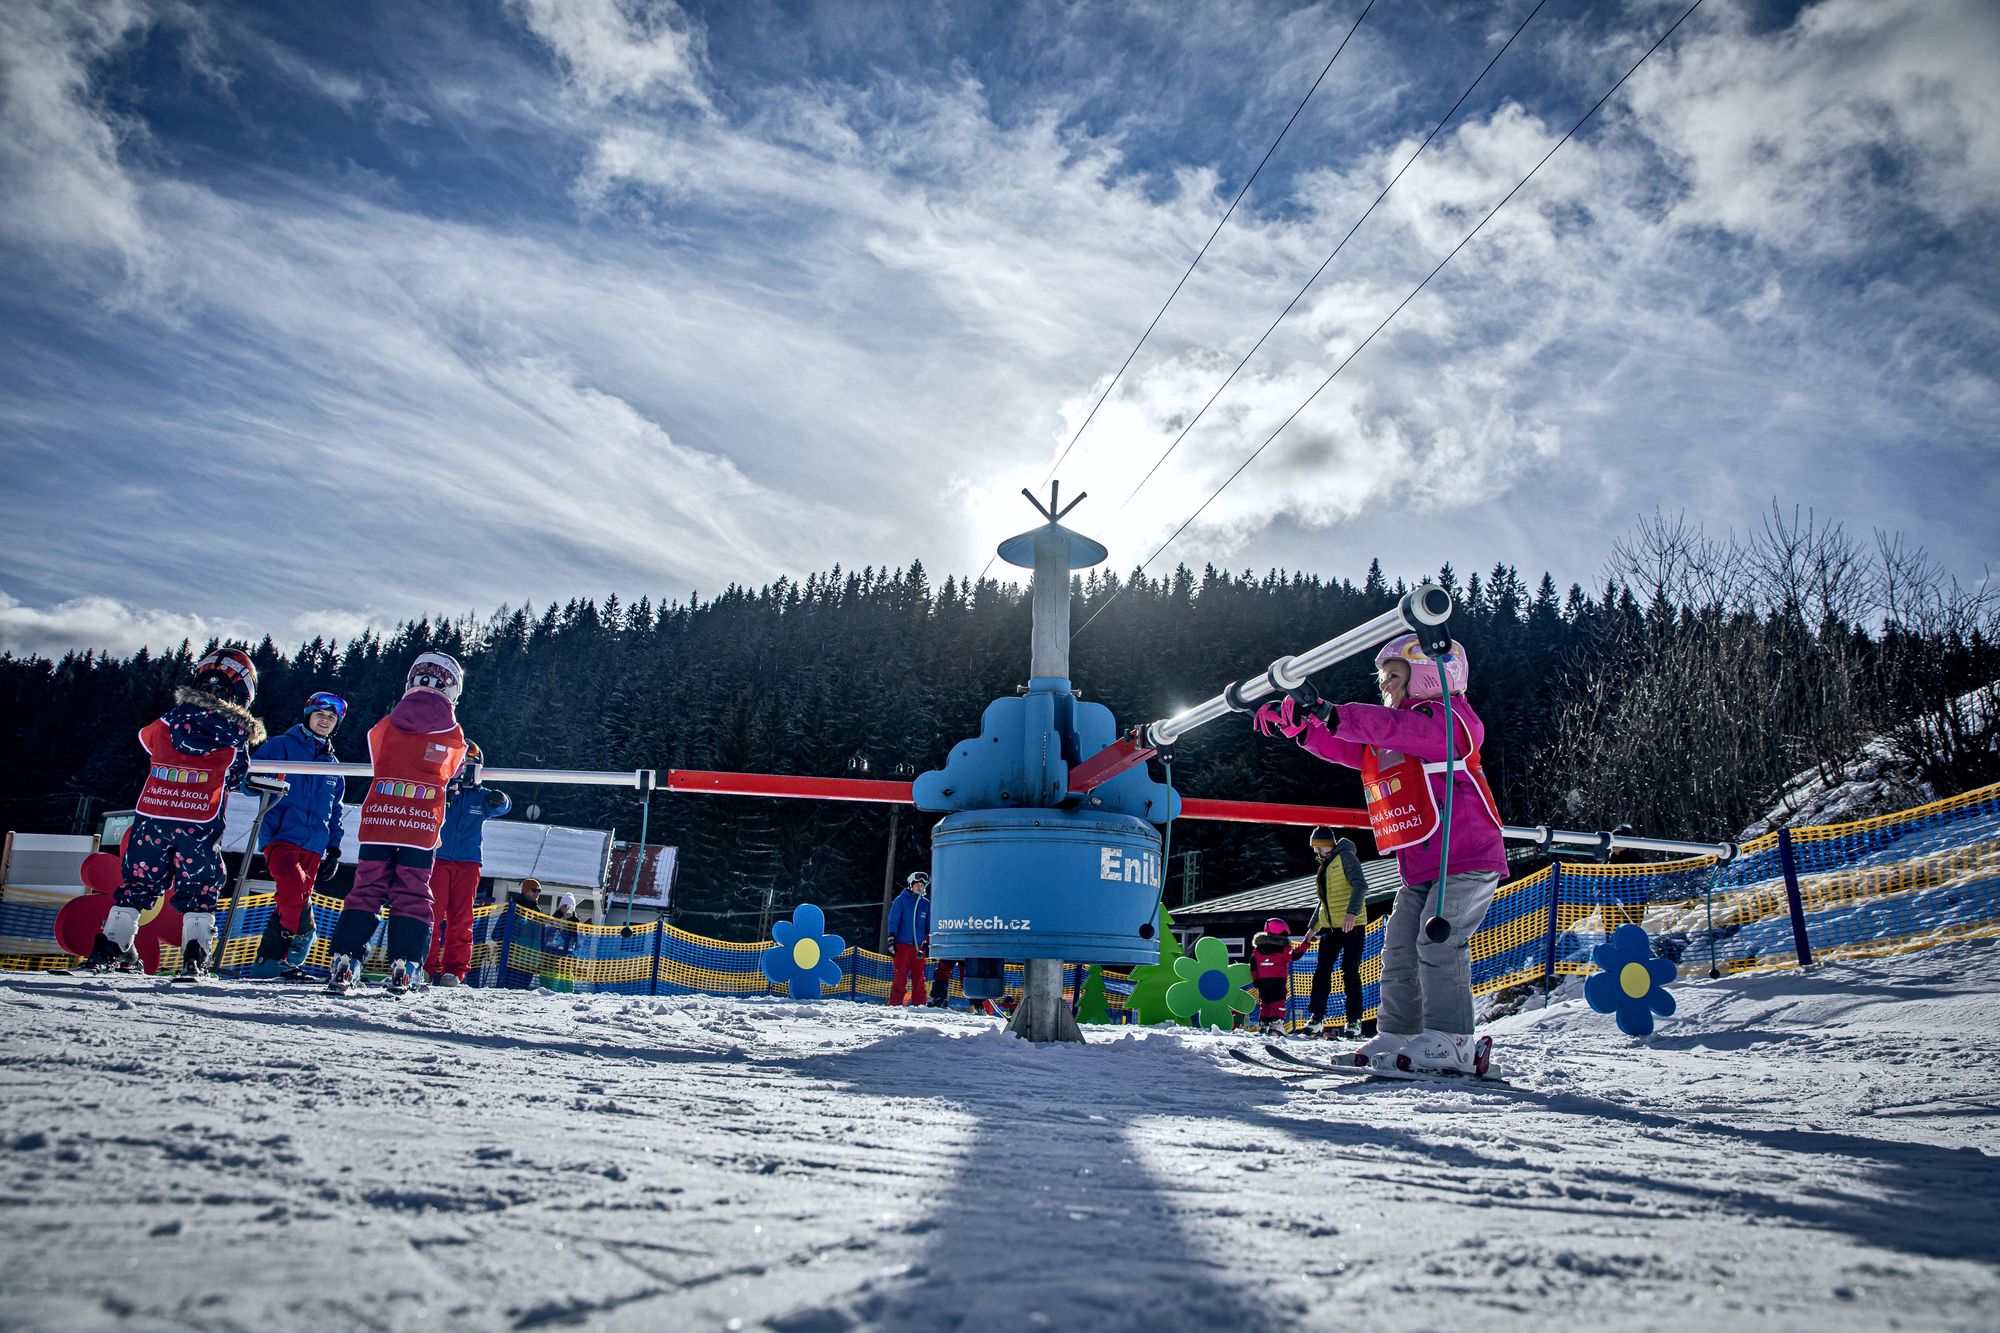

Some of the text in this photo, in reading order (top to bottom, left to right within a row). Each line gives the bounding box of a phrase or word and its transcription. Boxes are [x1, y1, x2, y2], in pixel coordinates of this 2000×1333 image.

[181, 789, 209, 800] ŠKOLA
[171, 800, 210, 811] NÁDRAŽÍ
[366, 803, 437, 820] LYŽAŘSKÁ ŠKOLA
[1384, 804, 1416, 819] ŠKOLA
[362, 817, 437, 832] PERNINK NÁDRAŽÍ
[1383, 814, 1422, 835] NÁDRAŽÍ
[938, 916, 1031, 930] snow-tech.cz
